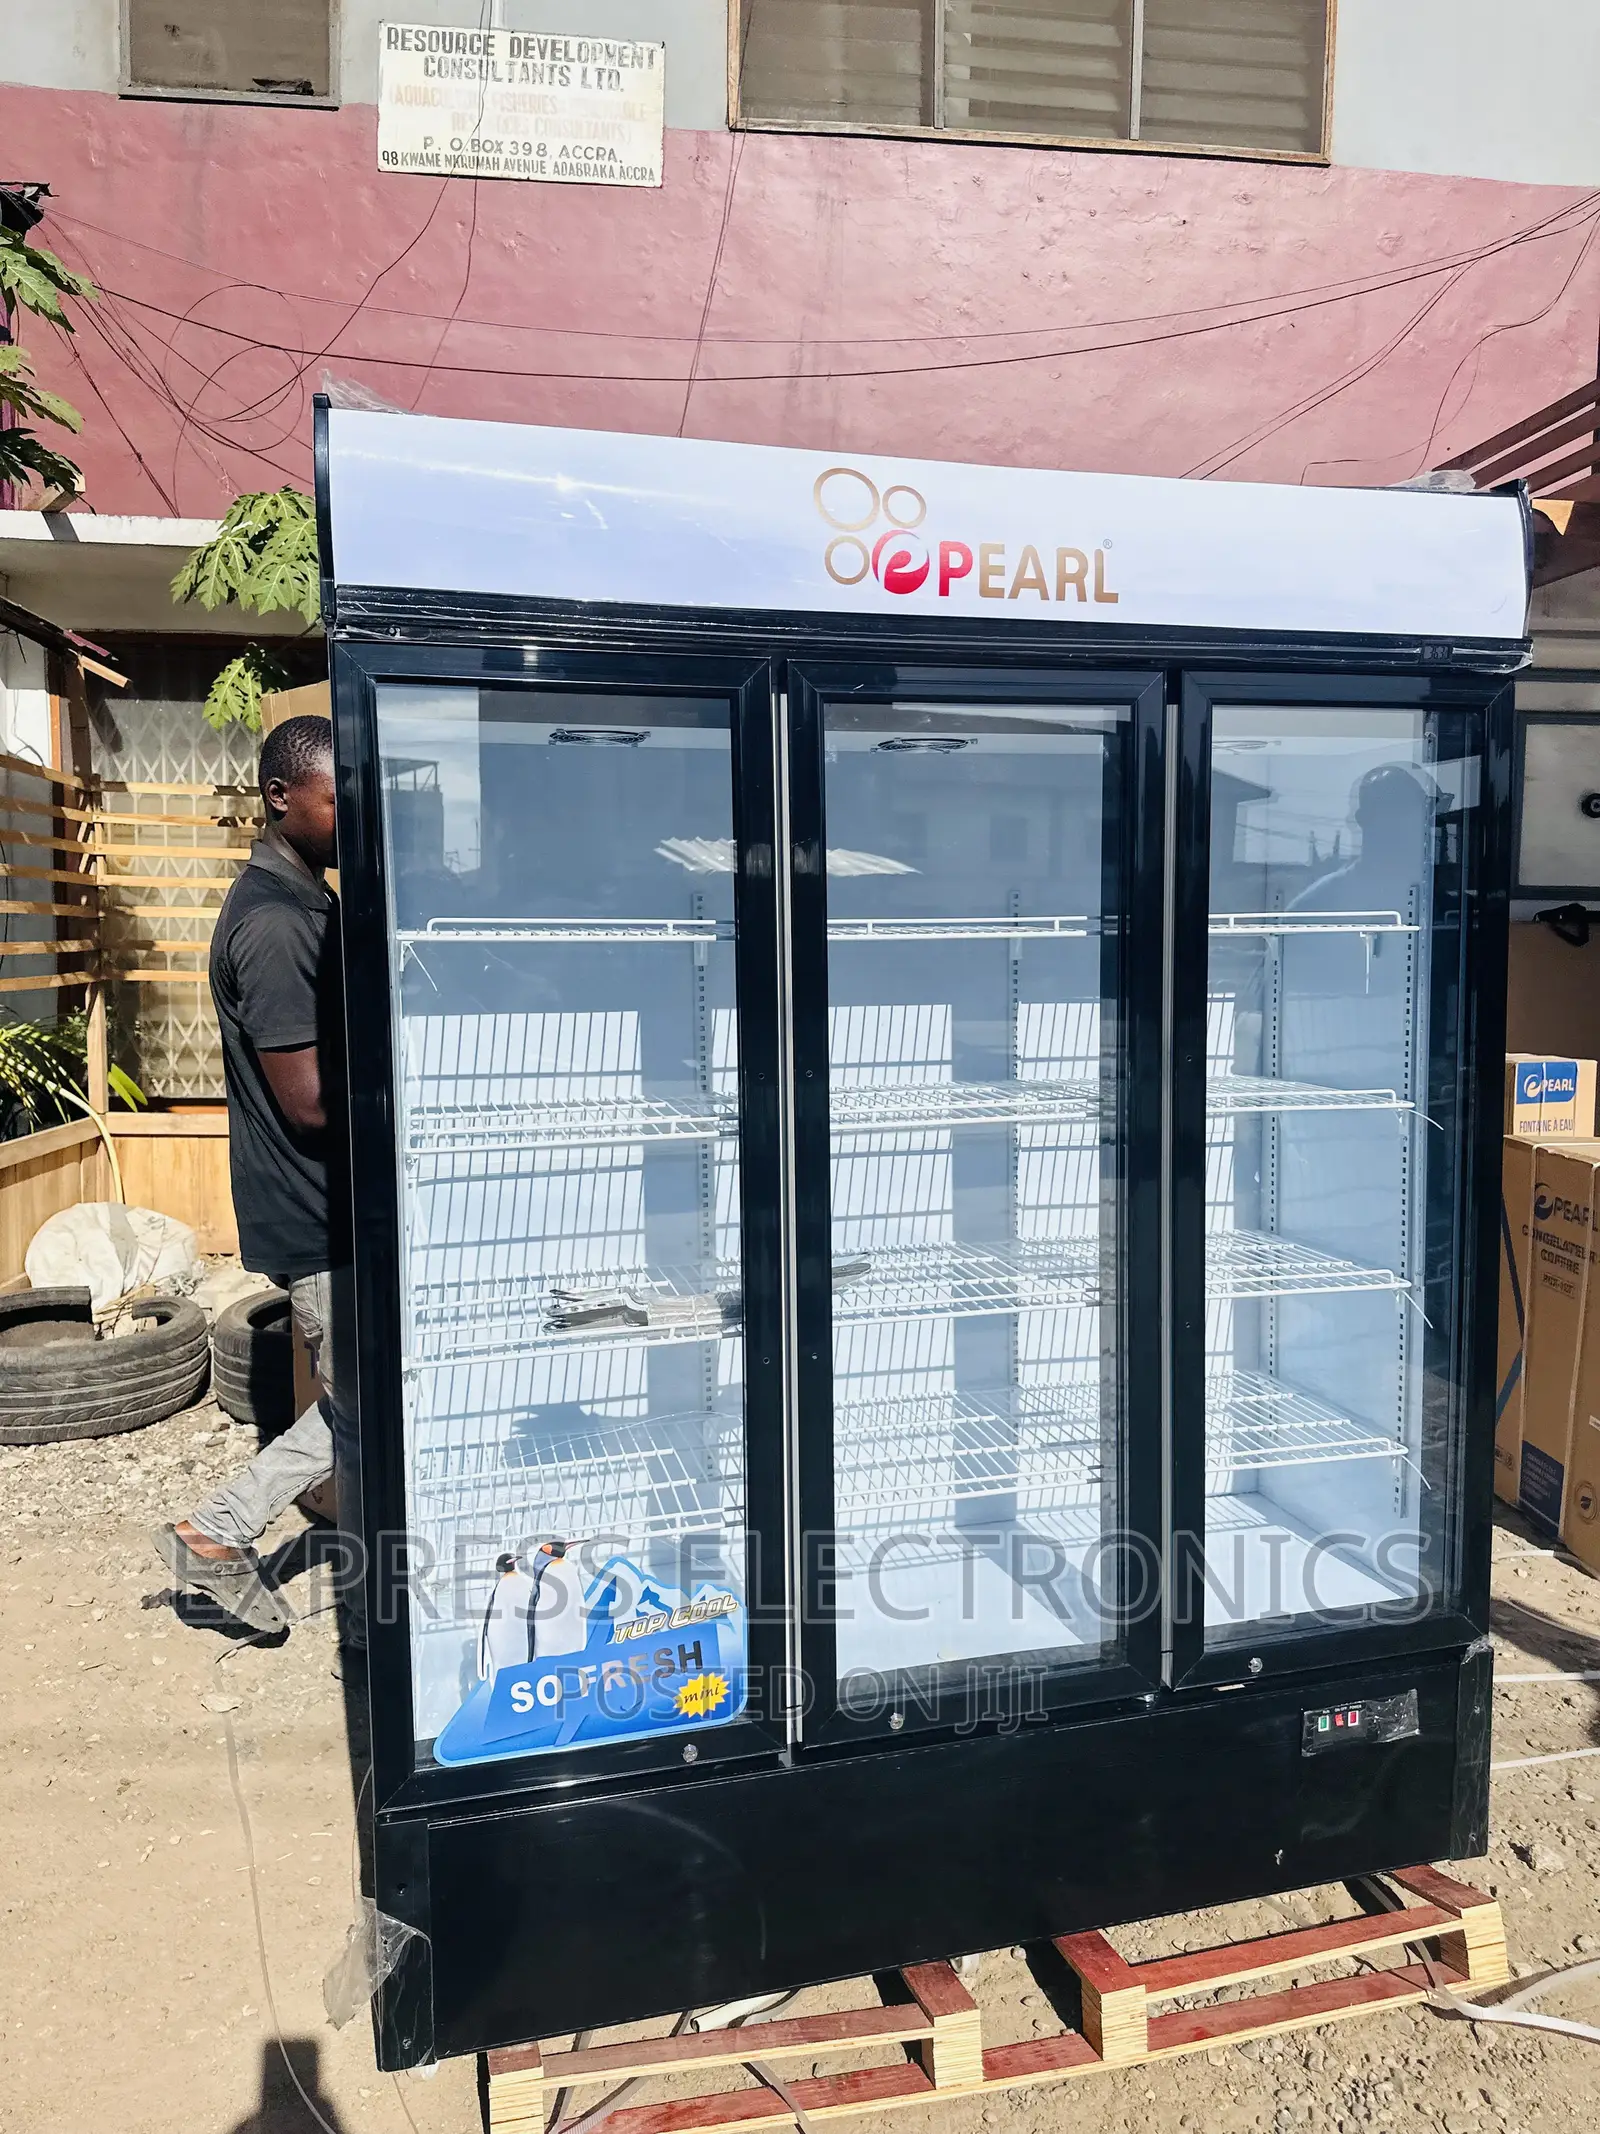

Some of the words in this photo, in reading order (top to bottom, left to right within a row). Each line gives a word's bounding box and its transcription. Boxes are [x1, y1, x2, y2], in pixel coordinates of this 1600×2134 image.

[387, 26, 496, 57] RESOURCE
[509, 36, 657, 69] DEVELOPMENT
[424, 55, 571, 87] CONSULTANTS
[580, 65, 624, 92] LTD.
[382, 150, 399, 166] 98
[400, 152, 441, 168] KWAME
[444, 154, 500, 171] NKRUMAH
[503, 158, 547, 174] AVENUE
[559, 144, 623, 163] ACCRA.
[938, 540, 1119, 604] PEARL
[1540, 1078, 1575, 1093] PEARL
[1521, 1224, 1597, 1264] CNGELATER
[614, 1611, 667, 1644] TOP
[668, 1593, 740, 1629] COOL
[510, 1674, 563, 1714] SO
[578, 1639, 703, 1698] FRESH
[683, 1683, 720, 1704] mini
